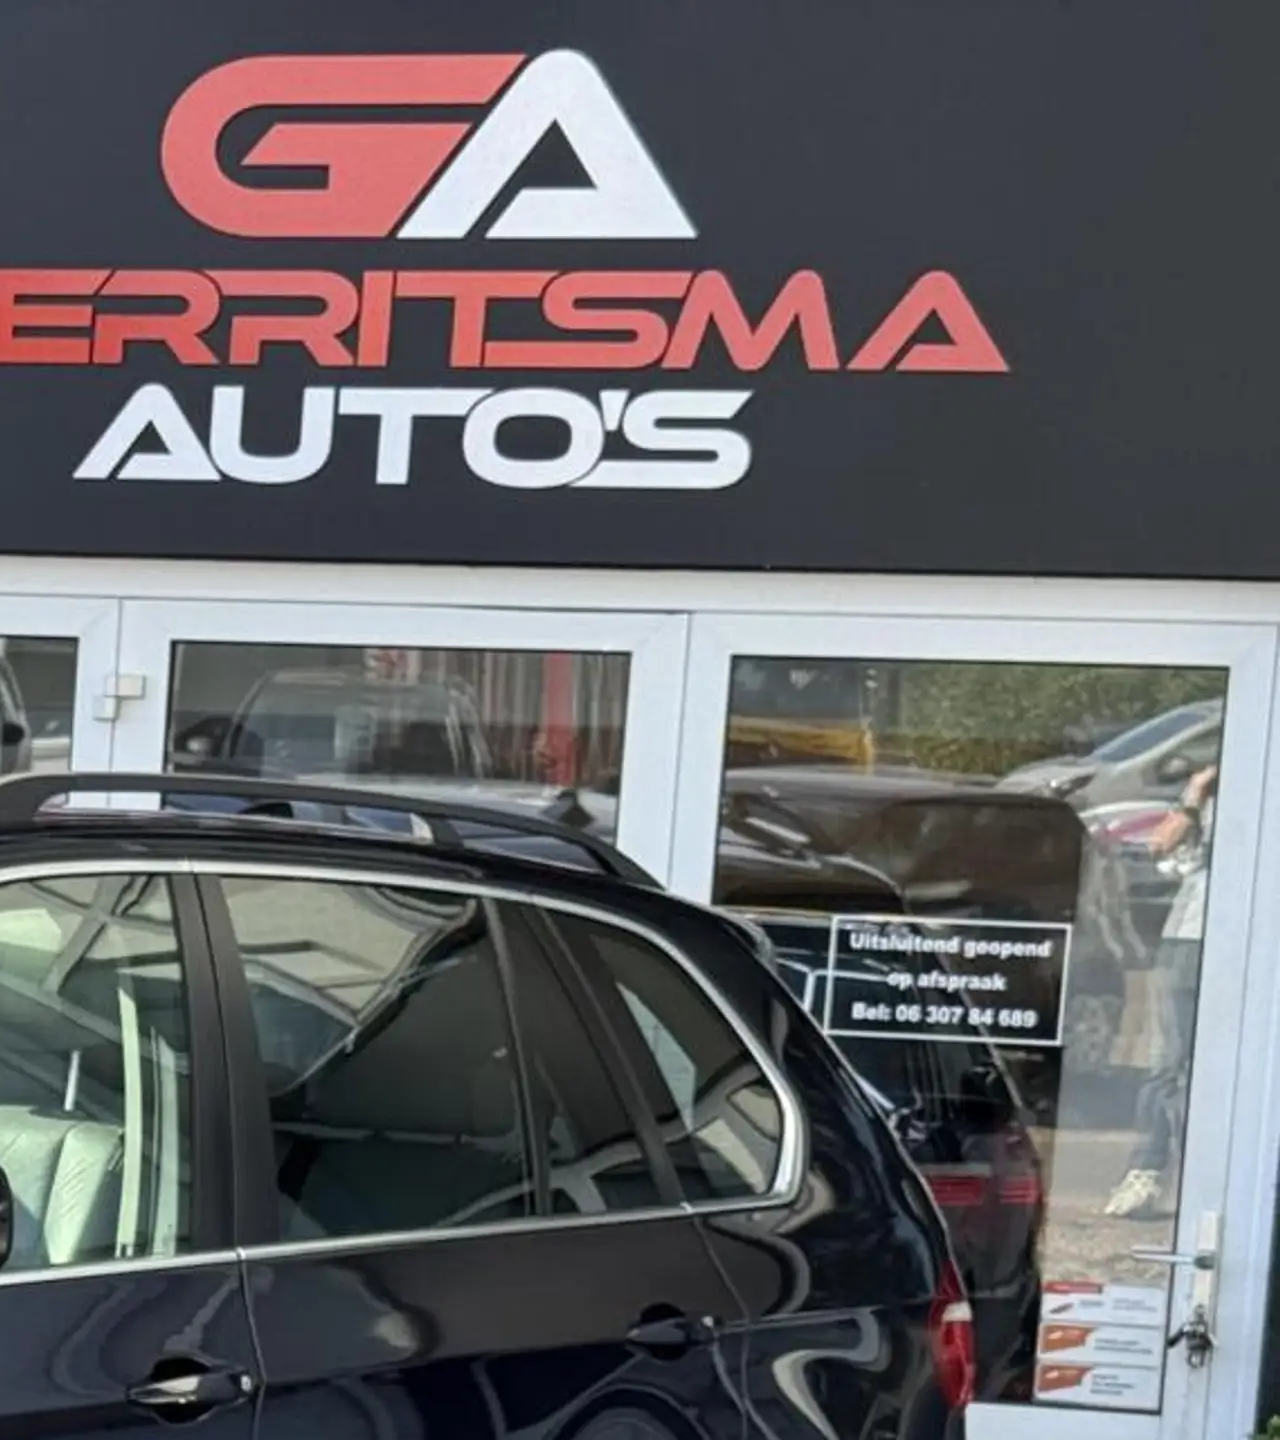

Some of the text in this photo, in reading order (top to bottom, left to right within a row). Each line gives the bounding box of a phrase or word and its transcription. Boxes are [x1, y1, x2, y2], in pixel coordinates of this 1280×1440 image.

[161, 49, 697, 240] GA
[72, 381, 753, 489] AUTO'S
[850, 932, 1052, 958] Uitsluitend geopend
[887, 971, 1006, 992] op afspraak
[851, 1002, 1037, 1028] Bel: 06 307 84 689
